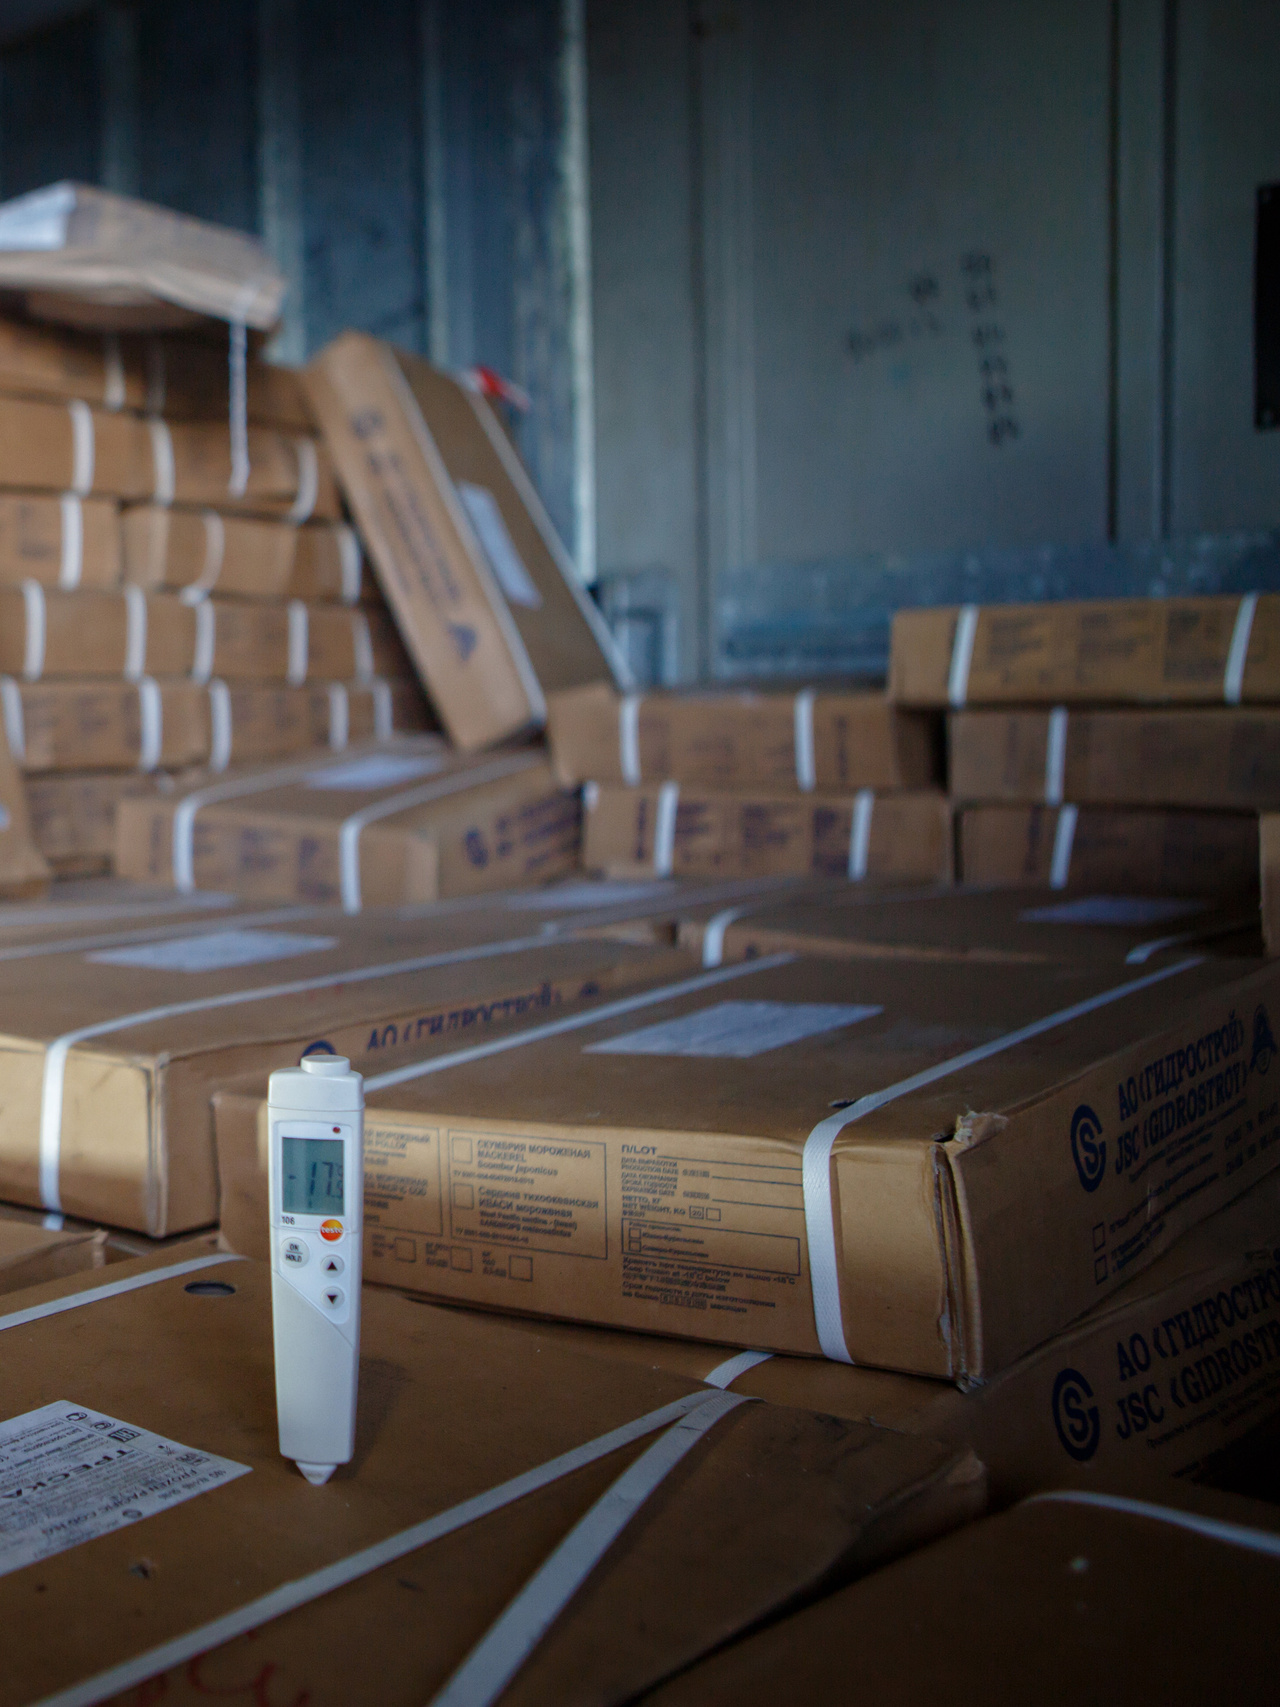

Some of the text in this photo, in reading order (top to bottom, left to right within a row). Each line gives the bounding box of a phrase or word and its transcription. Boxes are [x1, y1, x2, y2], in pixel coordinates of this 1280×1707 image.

[1118, 1076, 1138, 1121] АО
[477, 1139, 591, 1159] СКУМБРИЯ МОРОЖЕНАЯ
[477, 1150, 527, 1162] MACKEREL
[621, 1144, 657, 1156] П/LOT
[1115, 1124, 1140, 1175] JSC
[477, 1160, 515, 1171] Scomber
[621, 1164, 661, 1173] PRODUCTION
[662, 1167, 678, 1175] DATE
[478, 1186, 599, 1209] Сардина тихоокеанская
[478, 1198, 573, 1218] ИВАСИ мороженая
[321, 1226, 344, 1234] testo
[289, 1243, 300, 1252] ON
[285, 1253, 303, 1263] HOLD
[1117, 1333, 1151, 1381] АО
[1117, 1383, 1165, 1440] JSC
[0, 1448, 134, 1500] ТРЕСКА
[148, 1468, 197, 1493] FROZEN
